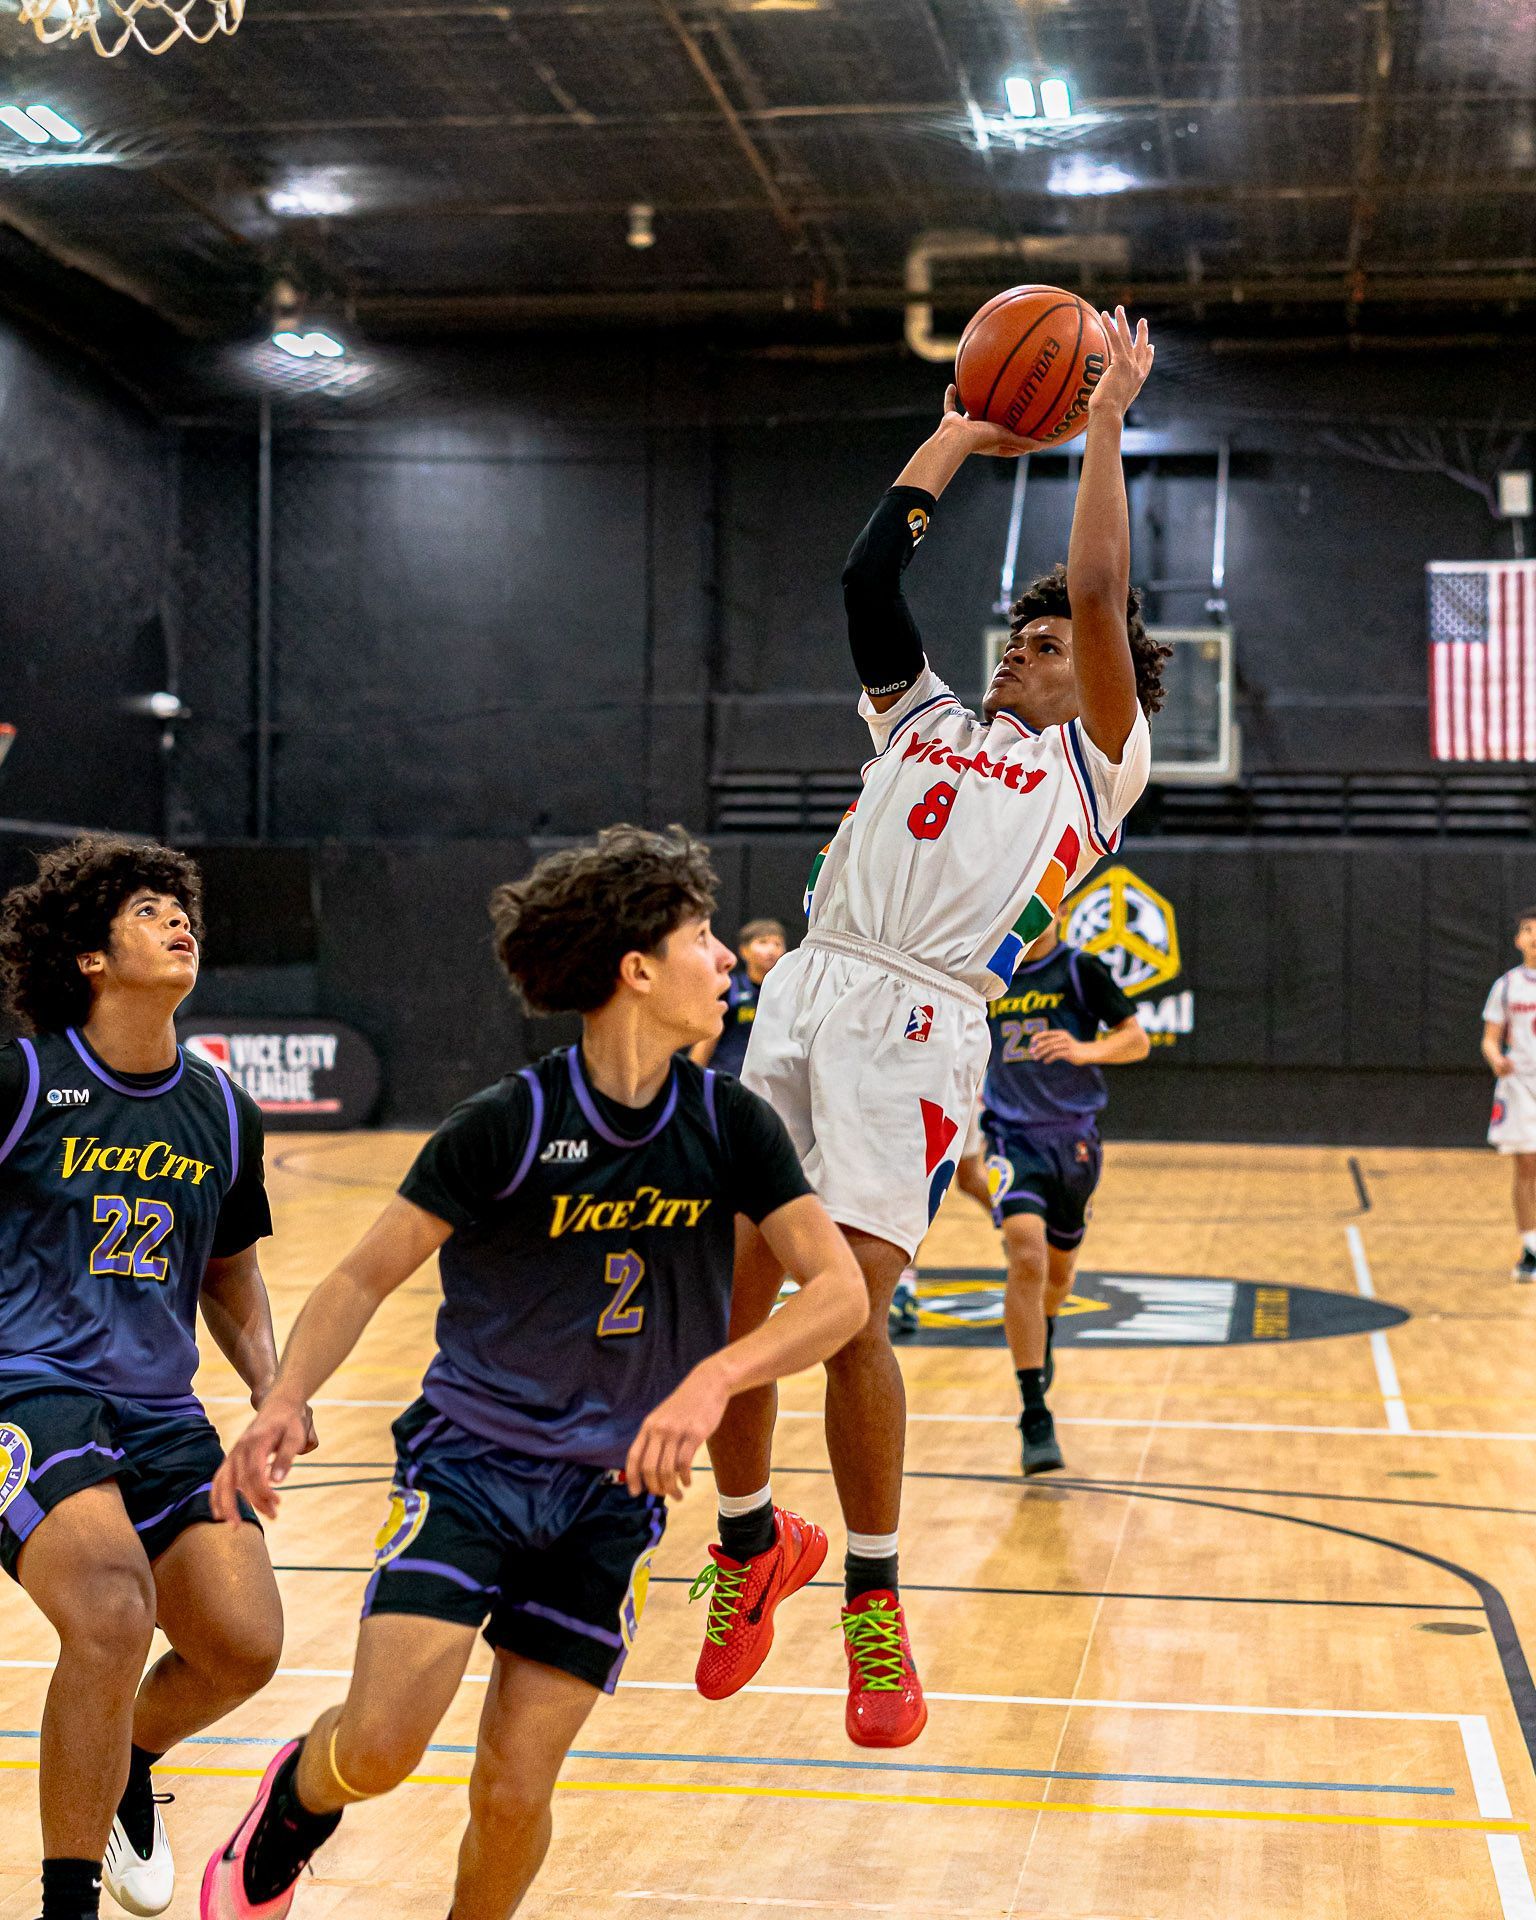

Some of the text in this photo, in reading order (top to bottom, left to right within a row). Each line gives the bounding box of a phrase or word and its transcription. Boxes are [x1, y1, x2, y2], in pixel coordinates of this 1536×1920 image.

[870, 680, 908, 695] COPPER
[907, 781, 958, 840] 8
[231, 1034, 338, 1070] VICE CITY
[47, 1089, 90, 1104] OTM
[90, 1195, 174, 1281] 22
[597, 1249, 645, 1337] 2
